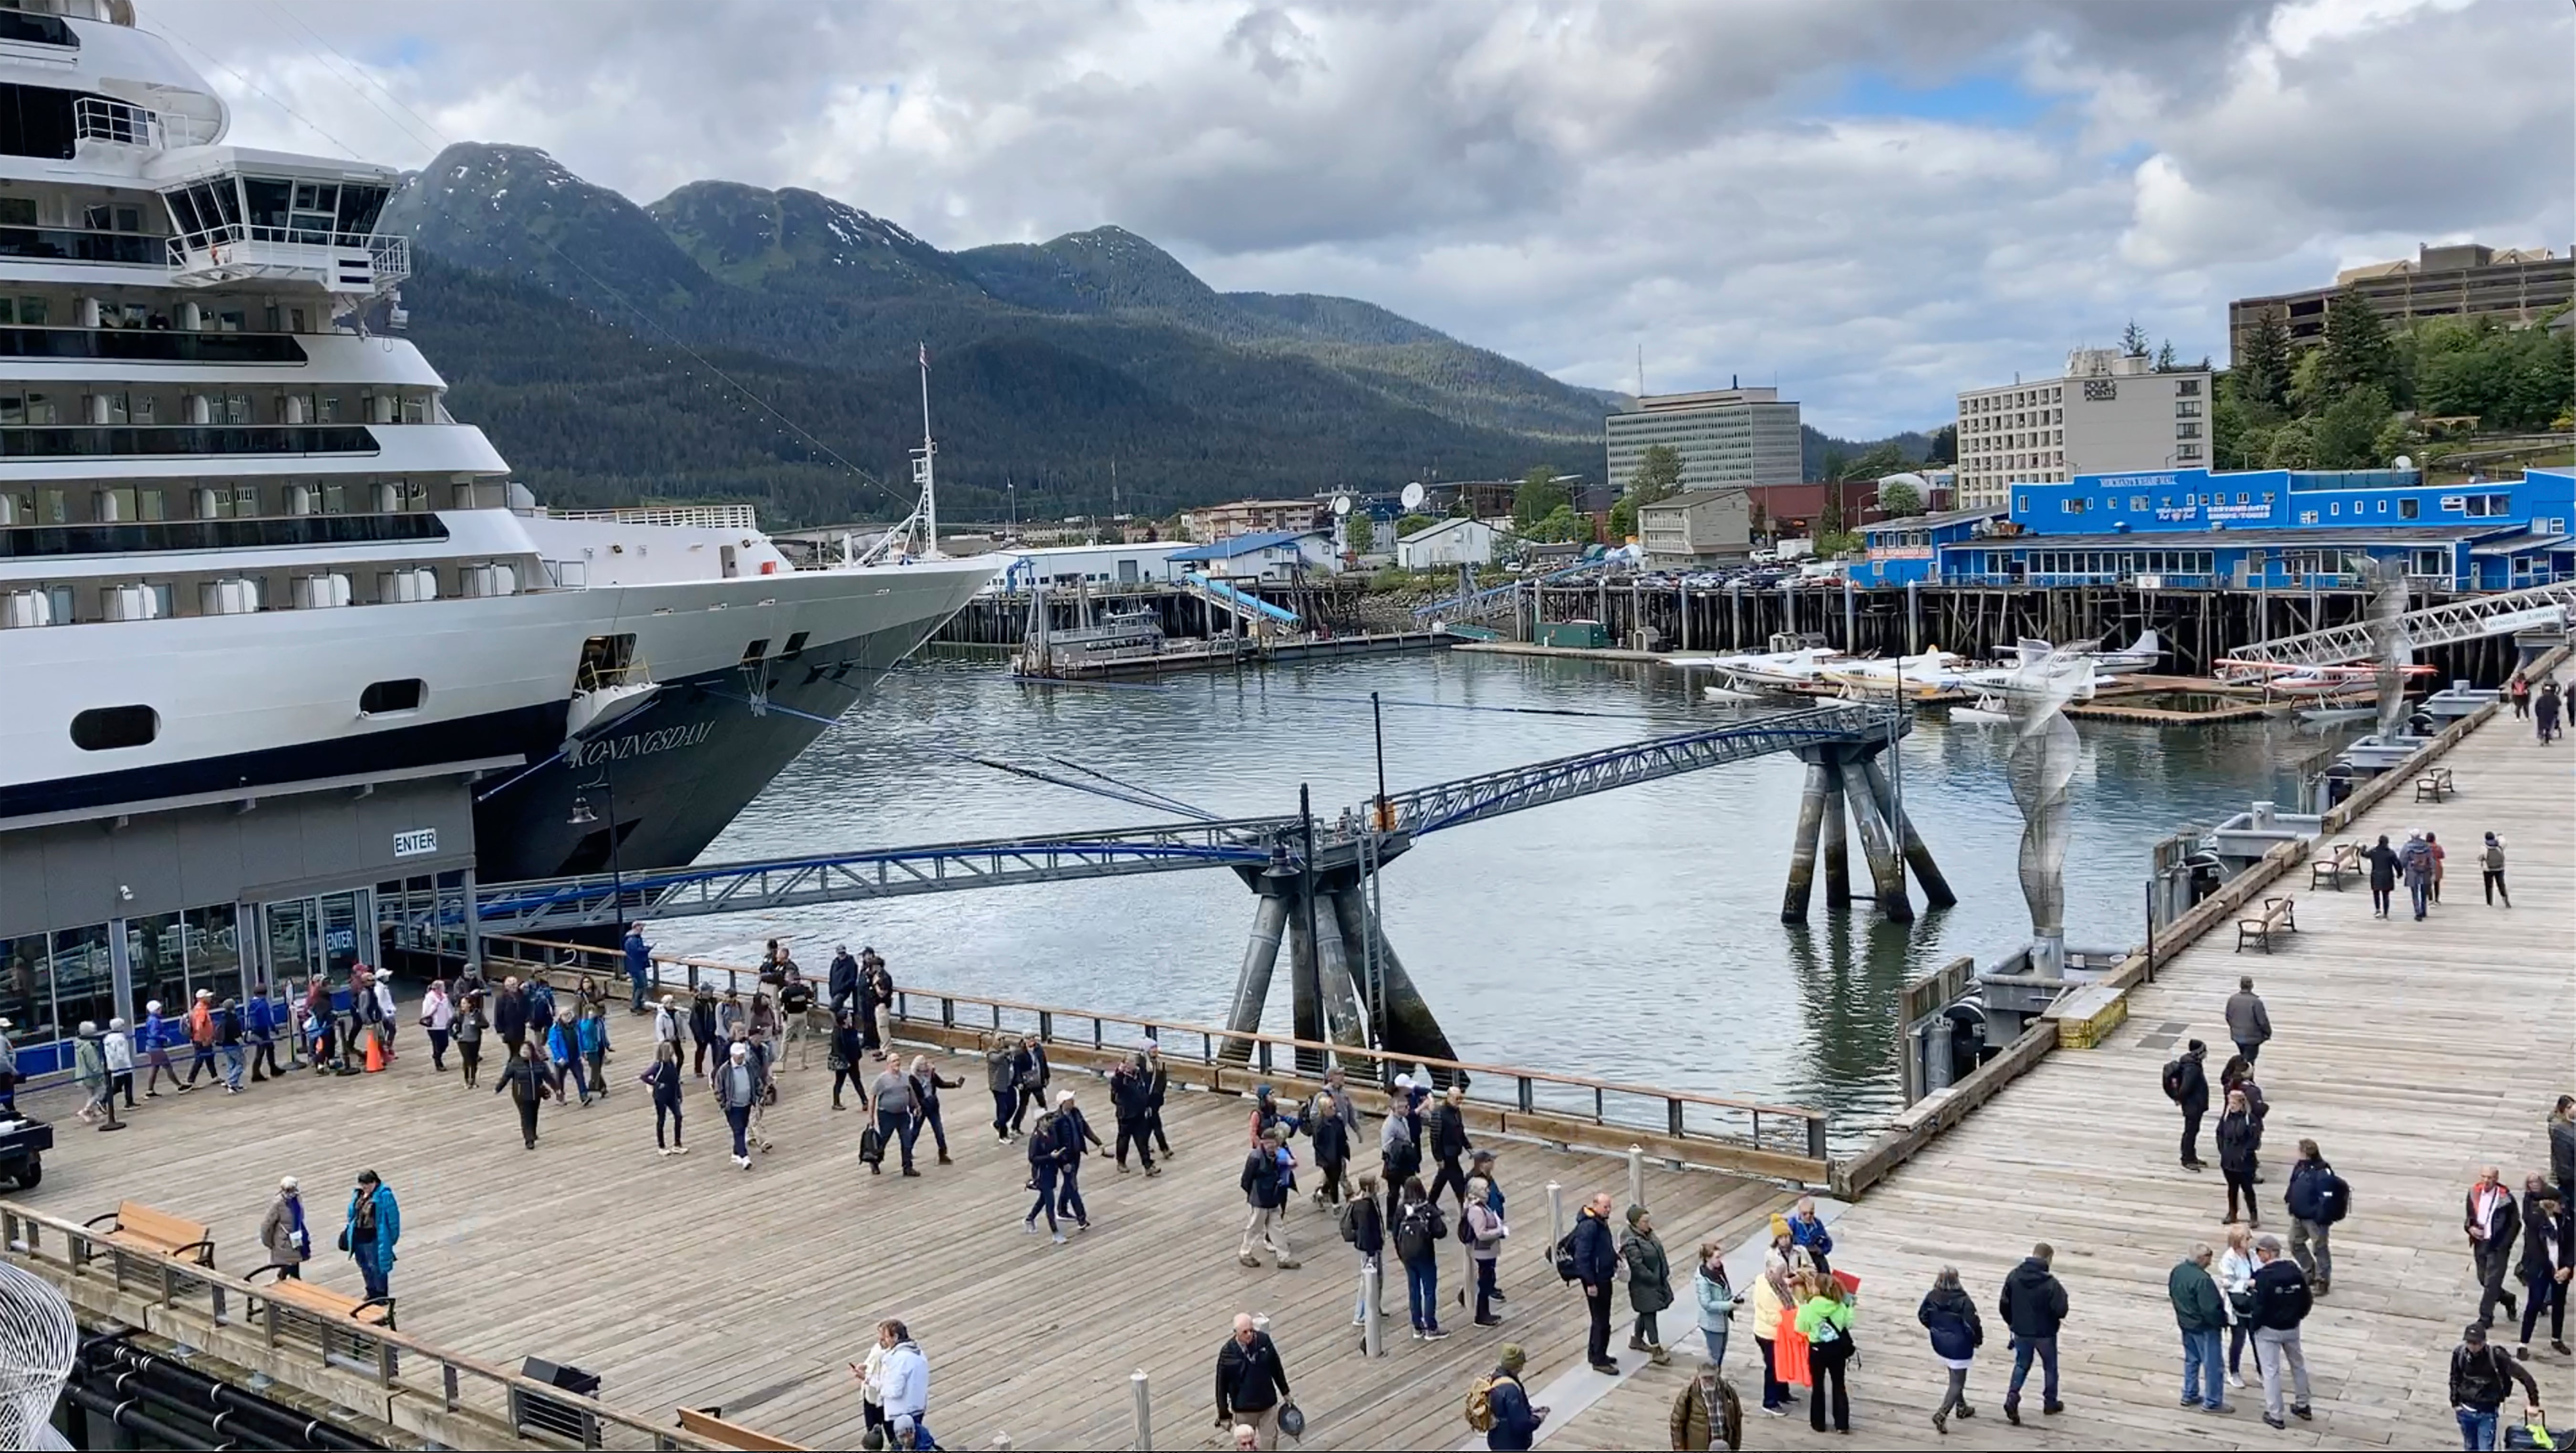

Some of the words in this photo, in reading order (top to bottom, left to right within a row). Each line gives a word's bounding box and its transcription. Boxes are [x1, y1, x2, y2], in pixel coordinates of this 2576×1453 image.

[2084, 388, 2117, 397] POINTS
[569, 719, 716, 769] KONINGSDAM
[395, 832, 436, 852] ENTER
[326, 930, 353, 951] ENTER
